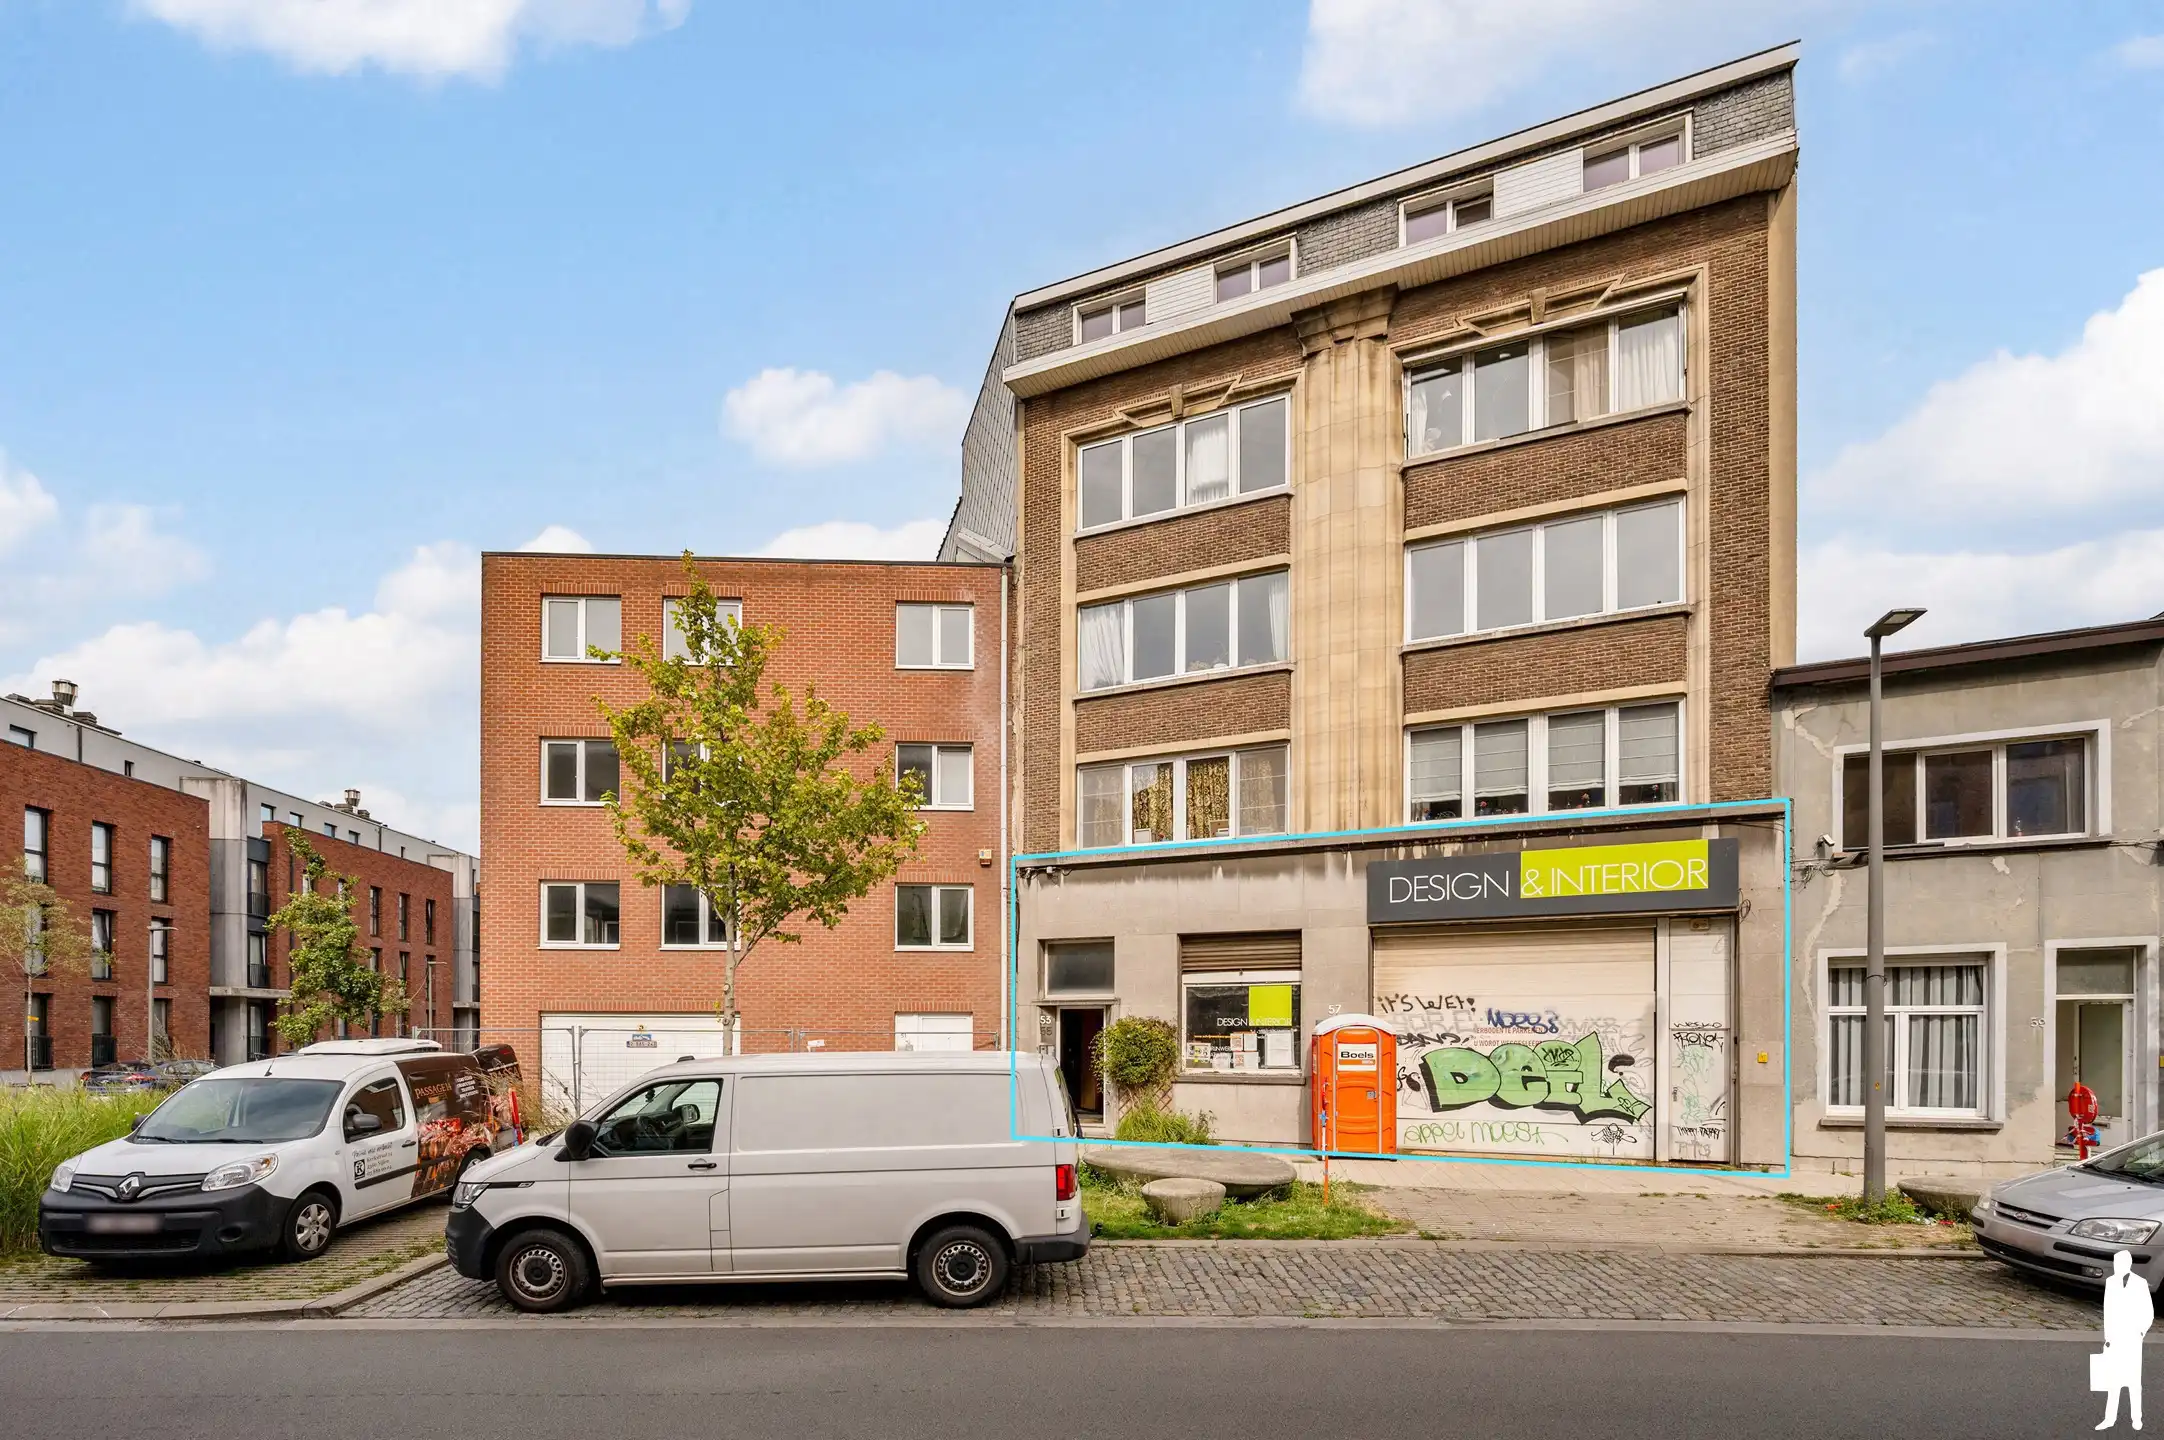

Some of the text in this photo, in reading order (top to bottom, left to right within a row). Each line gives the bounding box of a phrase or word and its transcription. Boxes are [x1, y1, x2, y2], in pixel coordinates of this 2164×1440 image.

[1389, 858, 1709, 903] DESIGN & INTERIOR
[1328, 1004, 1342, 1014] 57
[1040, 1015, 1052, 1024] 53
[1216, 1017, 1248, 1027] DESIGN
[1040, 1026, 1053, 1036] 55
[1340, 1051, 1375, 1059] Boels
